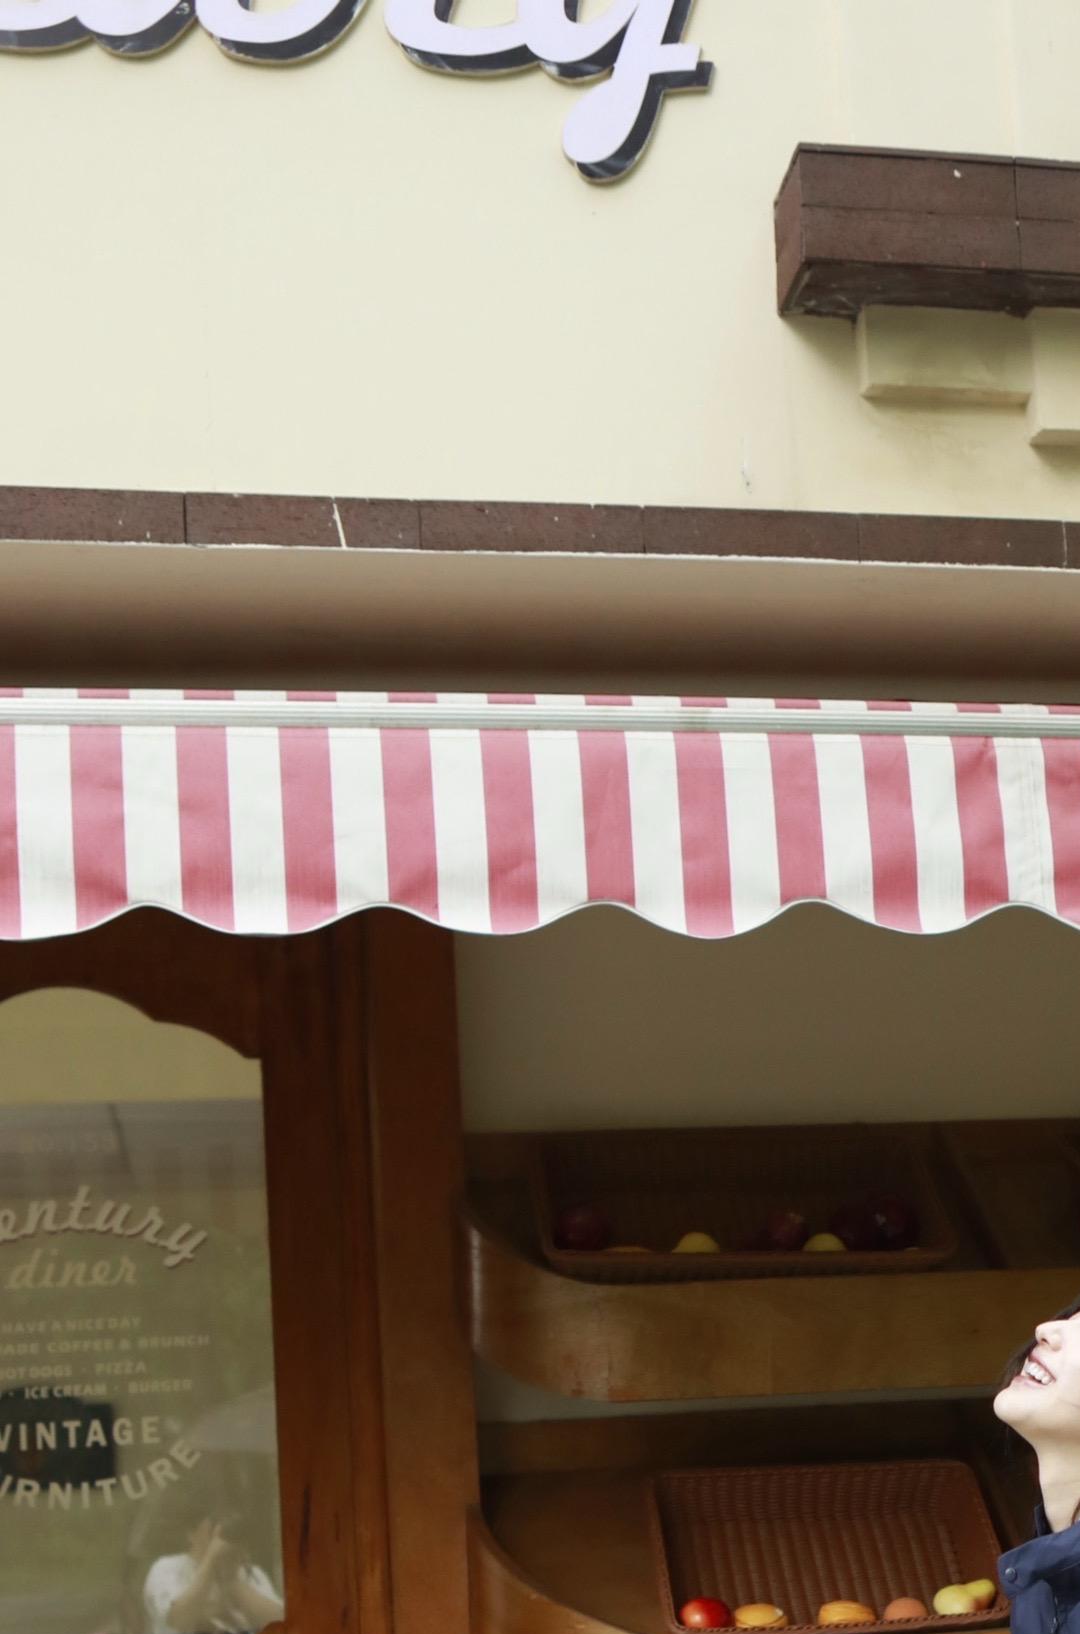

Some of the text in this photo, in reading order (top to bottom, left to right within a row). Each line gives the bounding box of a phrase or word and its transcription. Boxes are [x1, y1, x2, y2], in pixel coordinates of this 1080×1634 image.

[3, 1247, 138, 1289] diner
[0, 1341, 39, 1355] ADE
[47, 1338, 113, 1353] COFFEE
[138, 1334, 210, 1350] BRUNCH
[95, 1360, 146, 1375] PIZZA
[23, 1378, 193, 1400] ICE CREAM BURGER
